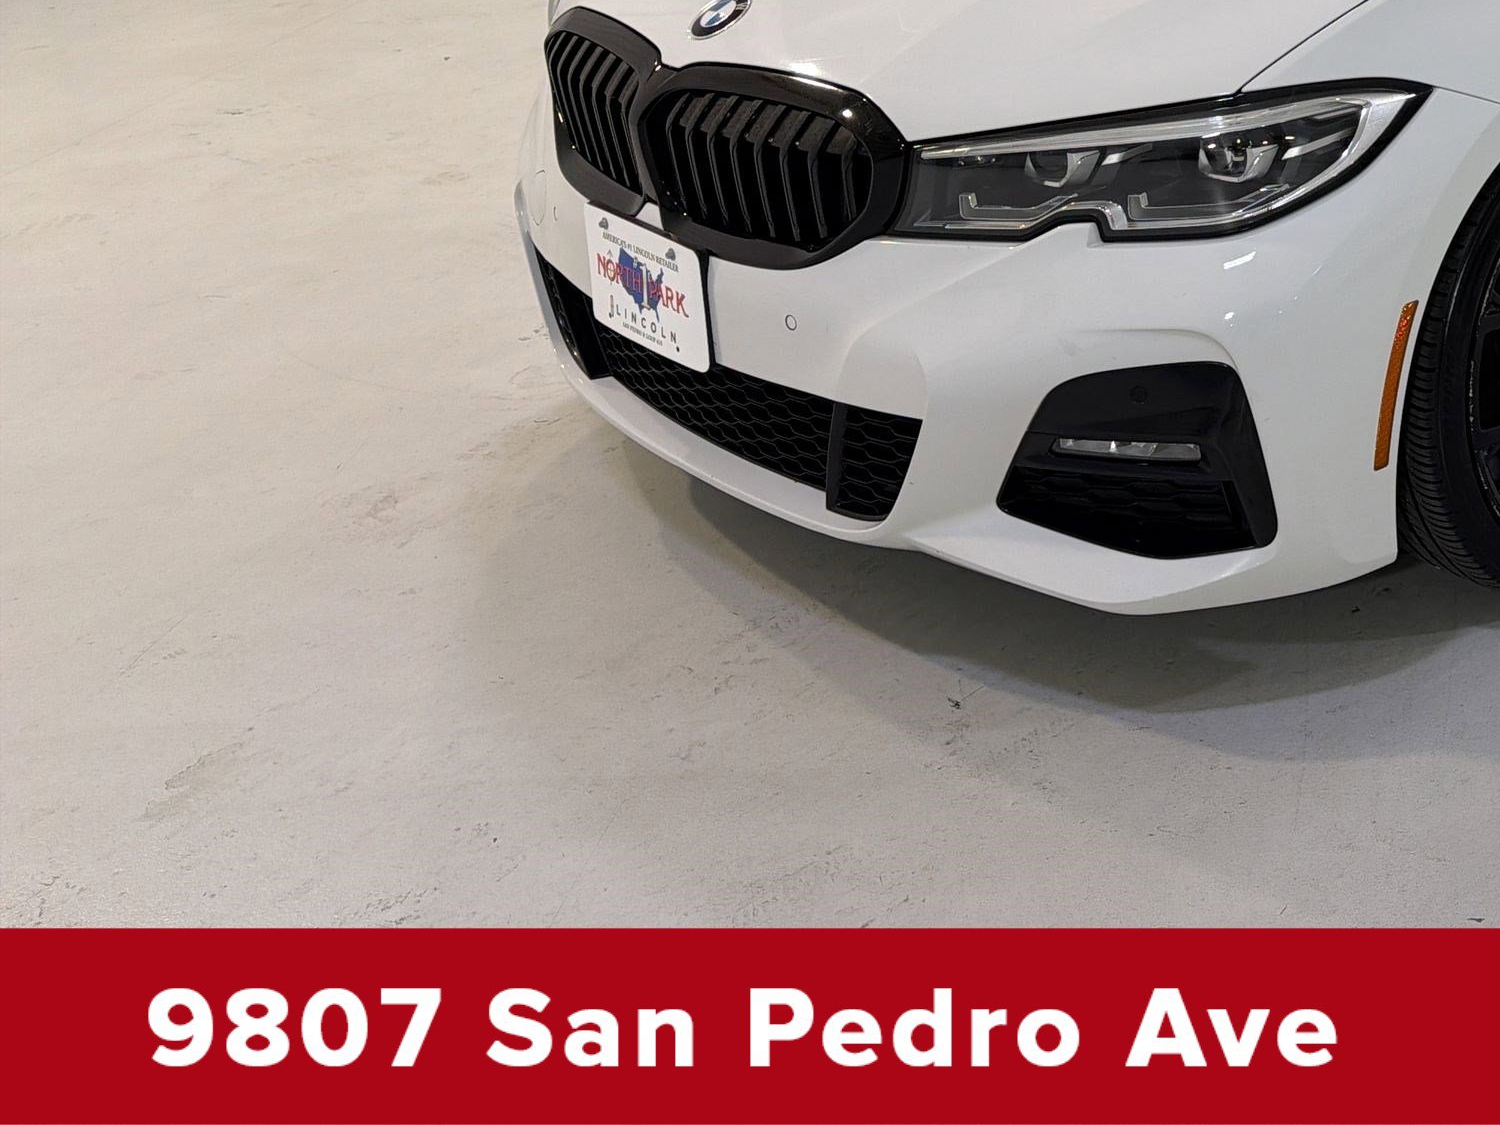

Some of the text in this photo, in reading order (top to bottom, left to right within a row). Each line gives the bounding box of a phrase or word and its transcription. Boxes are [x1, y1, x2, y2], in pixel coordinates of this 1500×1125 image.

[597, 253, 689, 318] NORTH PARK
[616, 304, 676, 343] LINCOLN
